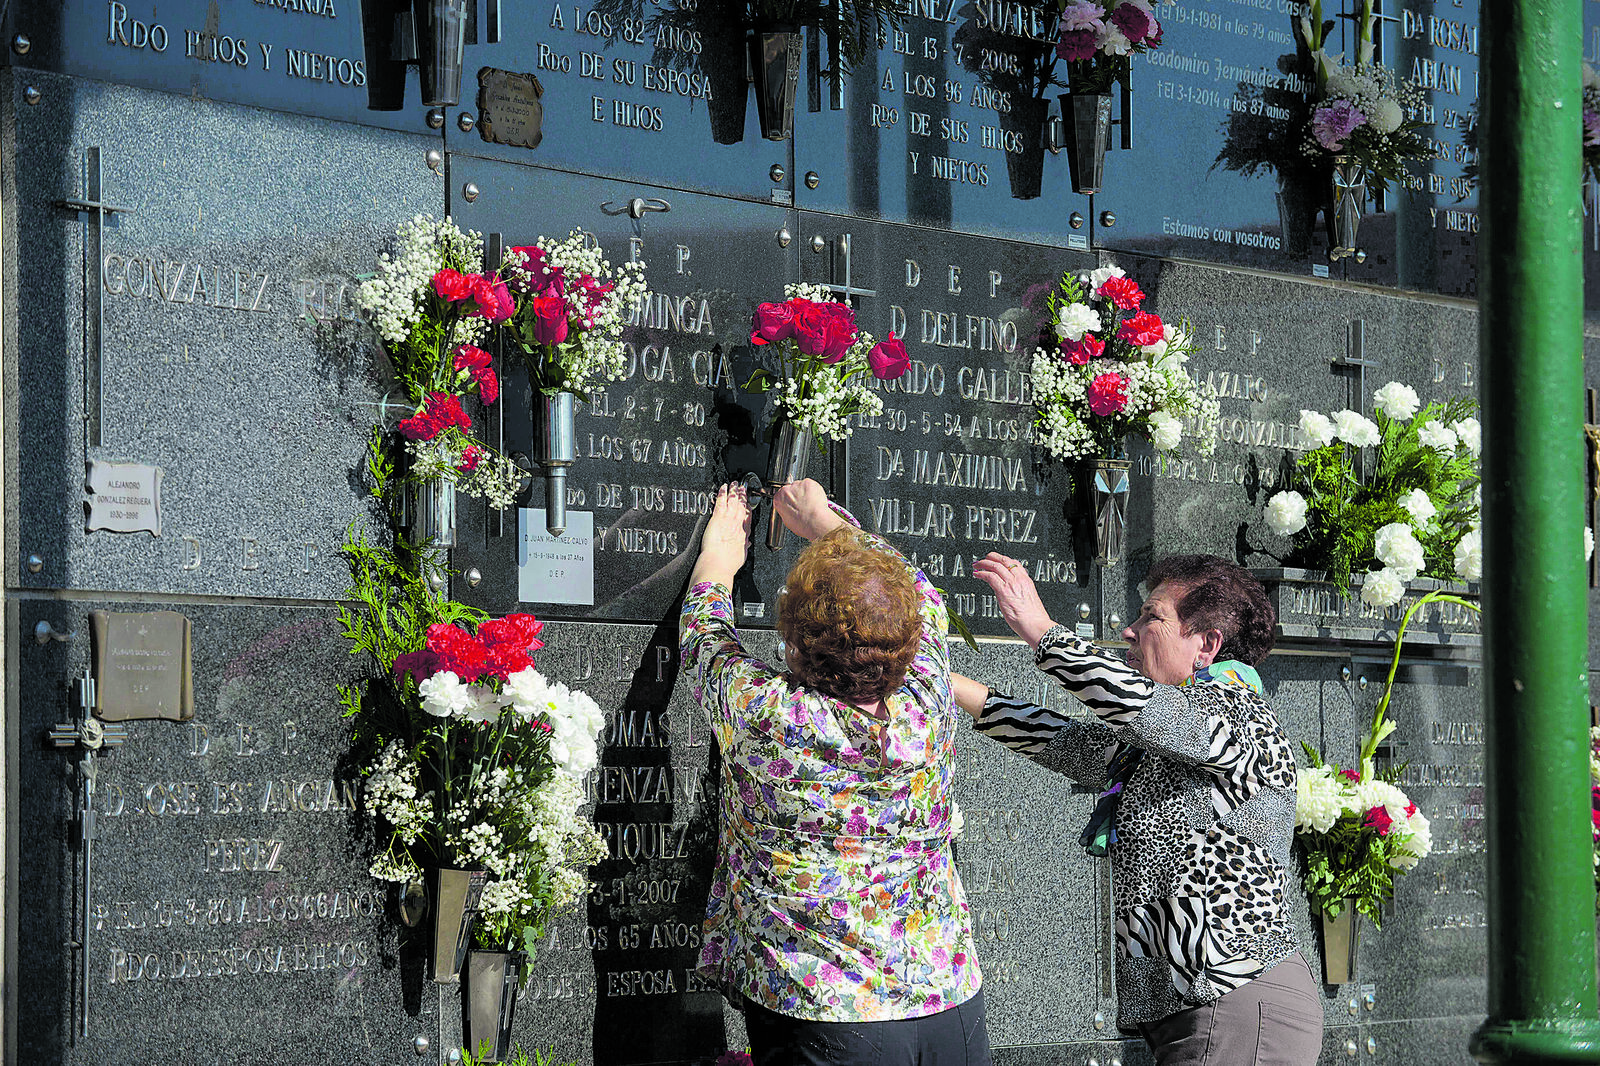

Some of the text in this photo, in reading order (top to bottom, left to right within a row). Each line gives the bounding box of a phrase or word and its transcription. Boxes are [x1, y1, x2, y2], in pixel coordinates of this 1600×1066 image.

[550, 7, 564, 30] A
[575, 10, 612, 38] LOS
[624, 18, 645, 43] 82
[1225, 20, 1232, 33] a
[1235, 18, 1249, 36] los
[1252, 22, 1265, 40] 79
[1268, 27, 1291, 45] años
[260, 42, 272, 71] Y
[286, 48, 366, 87] NIETOS
[580, 52, 606, 80] DE
[613, 60, 636, 86] SU
[644, 64, 713, 100] ESPOSA
[1411, 56, 1461, 96] ABIAN
[882, 67, 895, 91] A
[905, 71, 936, 98] LOS
[945, 80, 963, 103] 96
[1177, 84, 1219, 107] 3-1-2014
[1224, 98, 1230, 110] a
[1233, 95, 1247, 112] los
[1250, 98, 1264, 116] 87
[1266, 101, 1290, 121] años
[592, 96, 664, 132] E HIJOS
[910, 112, 932, 137] DE
[941, 118, 970, 144] SUS
[980, 125, 1024, 154] HIJOS
[910, 152, 989, 187] Y NIETOS
[1429, 173, 1446, 195] DE
[1449, 178, 1473, 199] SUS
[1163, 217, 1281, 251] Estamos con vosotros
[1429, 207, 1438, 229] Y
[103, 254, 271, 314] GONZALEZ
[906, 259, 1002, 298] D E P
[921, 308, 1018, 354] DELFINO
[590, 390, 616, 418] EL
[970, 416, 983, 439] A
[987, 417, 1018, 443] LOS
[1220, 416, 1309, 453] GONZALE
[589, 433, 623, 461] LOS
[631, 438, 652, 463] 67
[658, 437, 706, 468] AÑOS
[912, 449, 1028, 493] MAXIMINA
[1208, 461, 1219, 483] A
[97, 495, 126, 505] GONZALEZ
[597, 483, 623, 509] DE
[630, 486, 664, 512] TUS
[869, 498, 1038, 545] VILLAR PEREZ
[184, 537, 317, 573] D E P
[597, 526, 678, 556] Y NIETOS
[953, 553, 966, 577] A
[576, 644, 670, 682] D E P
[203, 839, 284, 873] PEREZ
[236, 896, 251, 924] A
[256, 893, 299, 922] LOS
[549, 919, 701, 951] A LOS 65 AÑOS
[607, 969, 678, 997] ESPOSA
